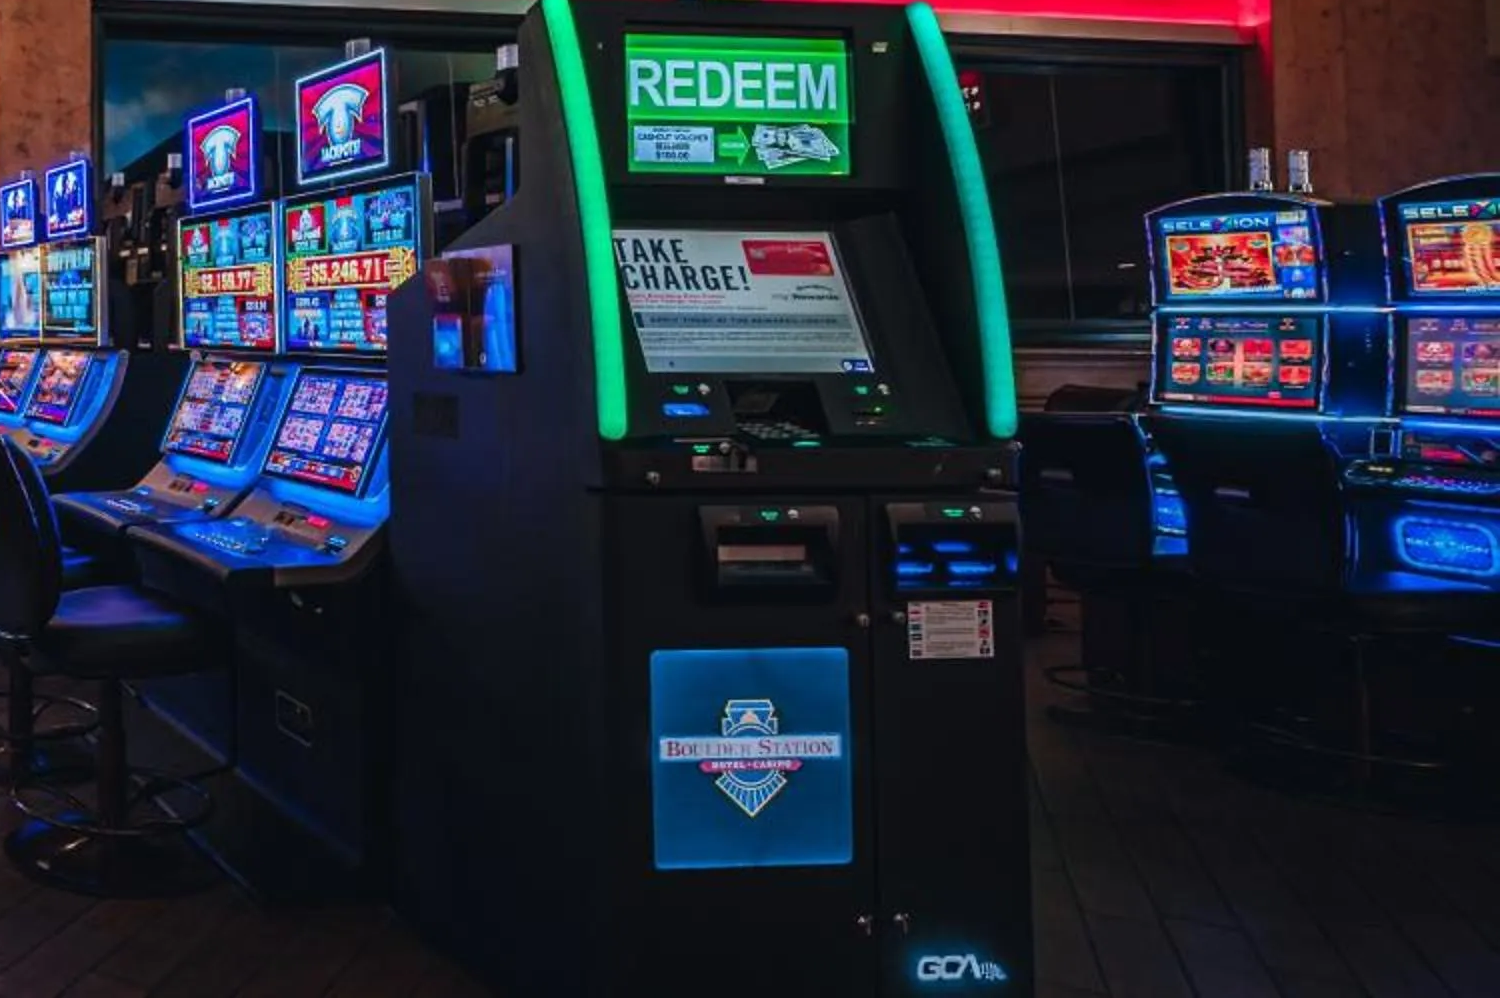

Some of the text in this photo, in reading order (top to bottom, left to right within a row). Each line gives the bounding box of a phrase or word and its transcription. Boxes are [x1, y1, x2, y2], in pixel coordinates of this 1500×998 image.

[629, 59, 838, 111] REDEEM
[613, 238, 689, 263] TAKE
[623, 265, 752, 291] CHARGE!
[667, 739, 834, 757] BOULDER STATION
